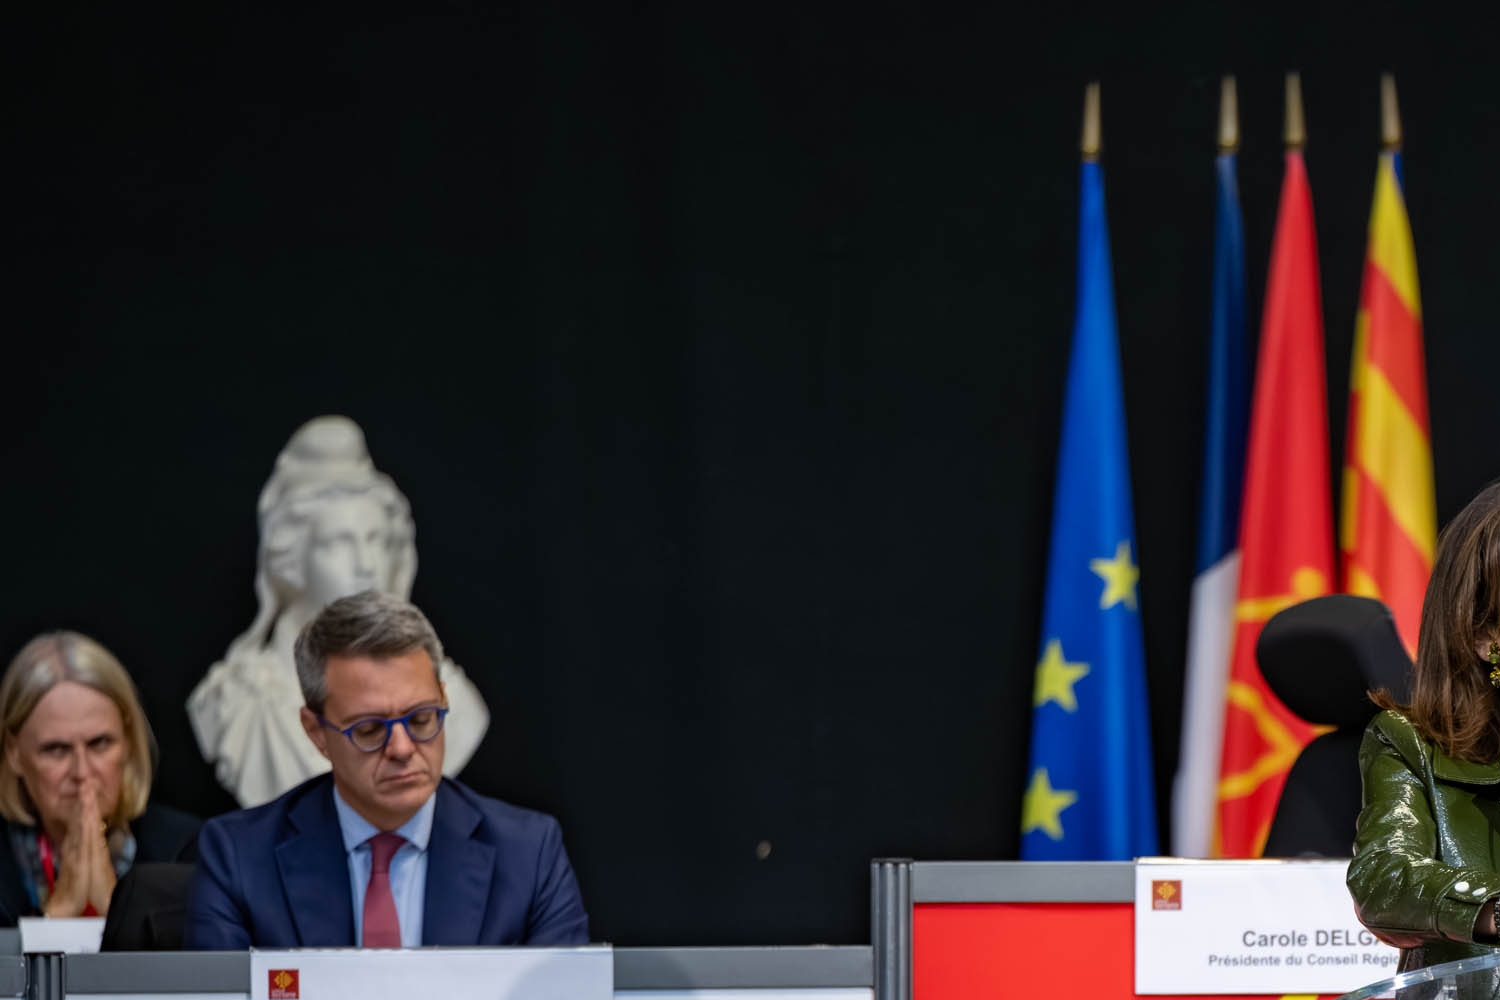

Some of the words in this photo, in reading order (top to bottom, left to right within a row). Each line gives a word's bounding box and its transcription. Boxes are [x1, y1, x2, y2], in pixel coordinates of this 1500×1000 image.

[1242, 930, 1308, 948] Carole
[1208, 953, 1281, 967] Présidente
[1285, 953, 1302, 966] du
[1307, 953, 1358, 966] Conseil
